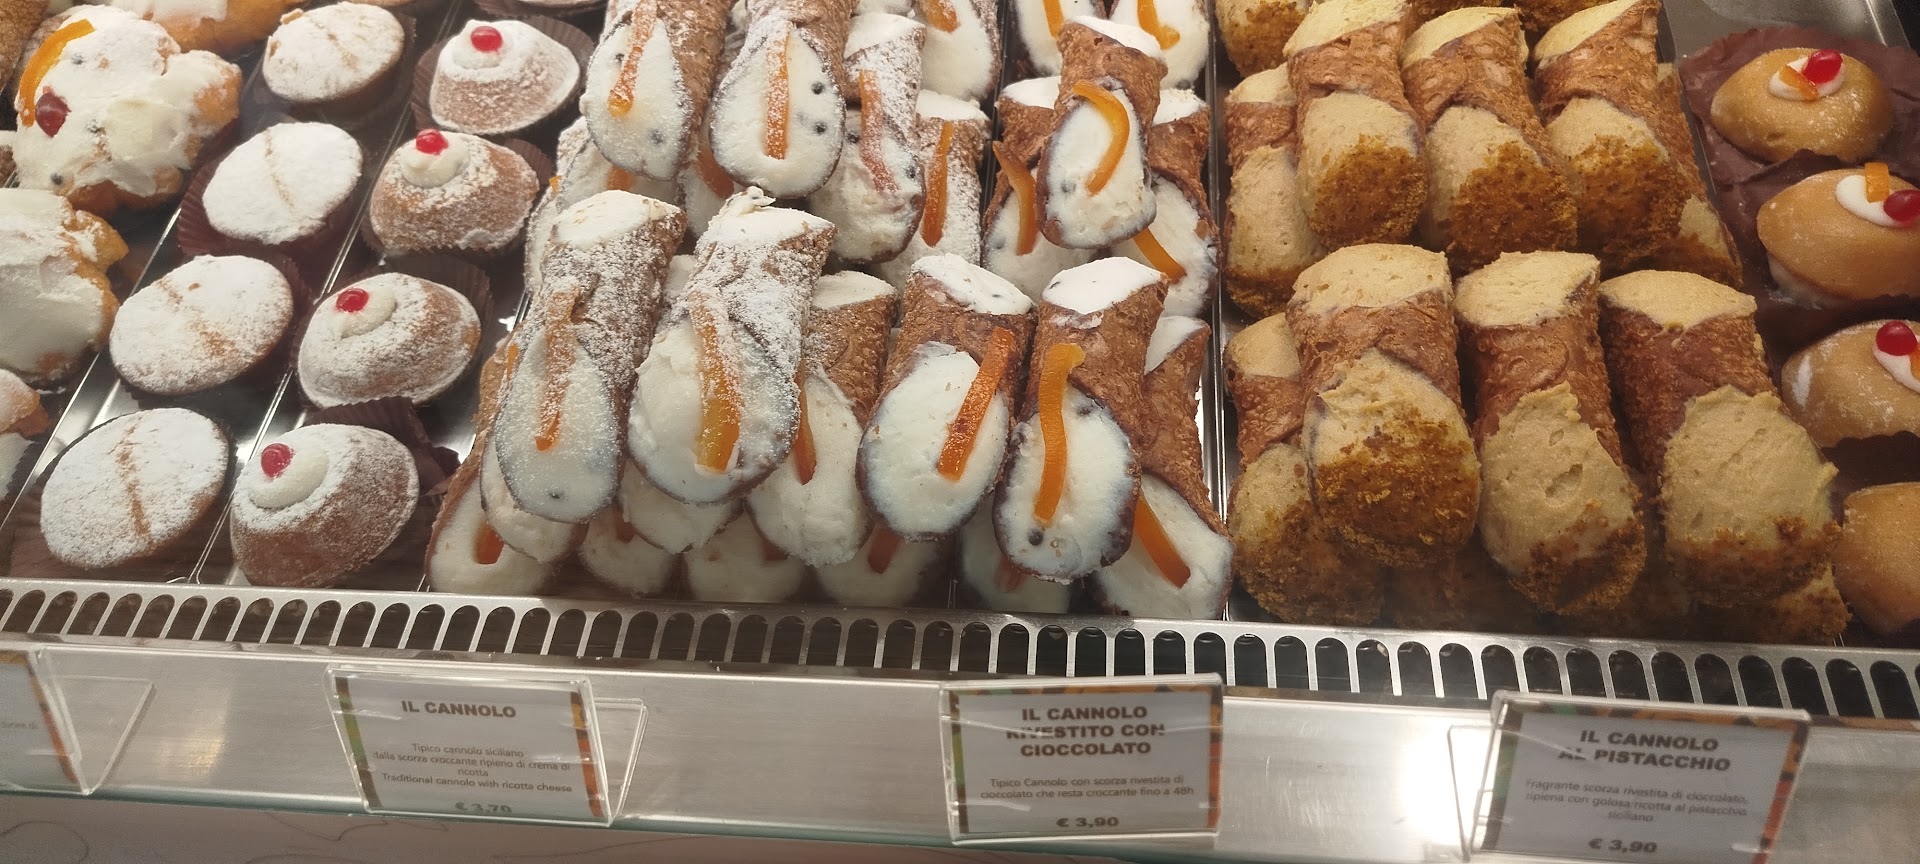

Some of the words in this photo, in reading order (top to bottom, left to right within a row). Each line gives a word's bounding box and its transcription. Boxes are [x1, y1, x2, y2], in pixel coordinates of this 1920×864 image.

[402, 700, 419, 713] IL
[424, 702, 517, 718] CANNOLO
[1022, 708, 1041, 721] IL
[1047, 706, 1148, 720] CANNOLO
[1121, 724, 1165, 736] CON
[1580, 730, 1600, 743] IL
[1607, 732, 1719, 751] CANNOLO
[411, 743, 441, 753] Tipico
[443, 746, 482, 755] cannolo
[484, 748, 524, 757] siciliano
[1020, 742, 1151, 757] CIOCCOLATO
[398, 754, 427, 763] scorza
[430, 757, 477, 766] croccante
[480, 759, 513, 769] ripieno
[516, 761, 525, 769] di
[528, 762, 558, 771] crema
[561, 763, 571, 771] di
[1594, 749, 1731, 771] PISTACCHIO
[457, 768, 489, 778] ricotta
[382, 772, 433, 784] Traditional
[436, 778, 476, 787] cannolo
[478, 779, 499, 789] with
[502, 781, 534, 790] ricotta
[537, 782, 572, 792] cheese
[990, 778, 1021, 789] Tipico
[1024, 778, 1068, 787] Cannolo
[1071, 778, 1090, 787] con
[1094, 777, 1127, 786] scorza
[1130, 776, 1171, 785] rivestita
[1174, 774, 1184, 783] di
[1525, 779, 1580, 791] Fragrante
[1583, 784, 1620, 794] scorza
[1623, 786, 1669, 798] rivestita
[1672, 789, 1682, 799] di
[980, 789, 1033, 799] cioccolato
[1036, 789, 1055, 798] che
[1058, 789, 1083, 797] resta
[1086, 788, 1137, 797] croccante
[1140, 786, 1161, 796] fino
[1173, 786, 1194, 795] 48h
[1526, 793, 1564, 803] ripiena
[1567, 795, 1589, 803] con
[1592, 798, 1631, 807] golosa
[1633, 801, 1671, 811] ricotta
[1675, 804, 1686, 812] al
[1056, 817, 1070, 828] €
[1075, 817, 1119, 828] 3,90
[1588, 837, 1604, 849] €
[1608, 839, 1658, 853] 3,90
